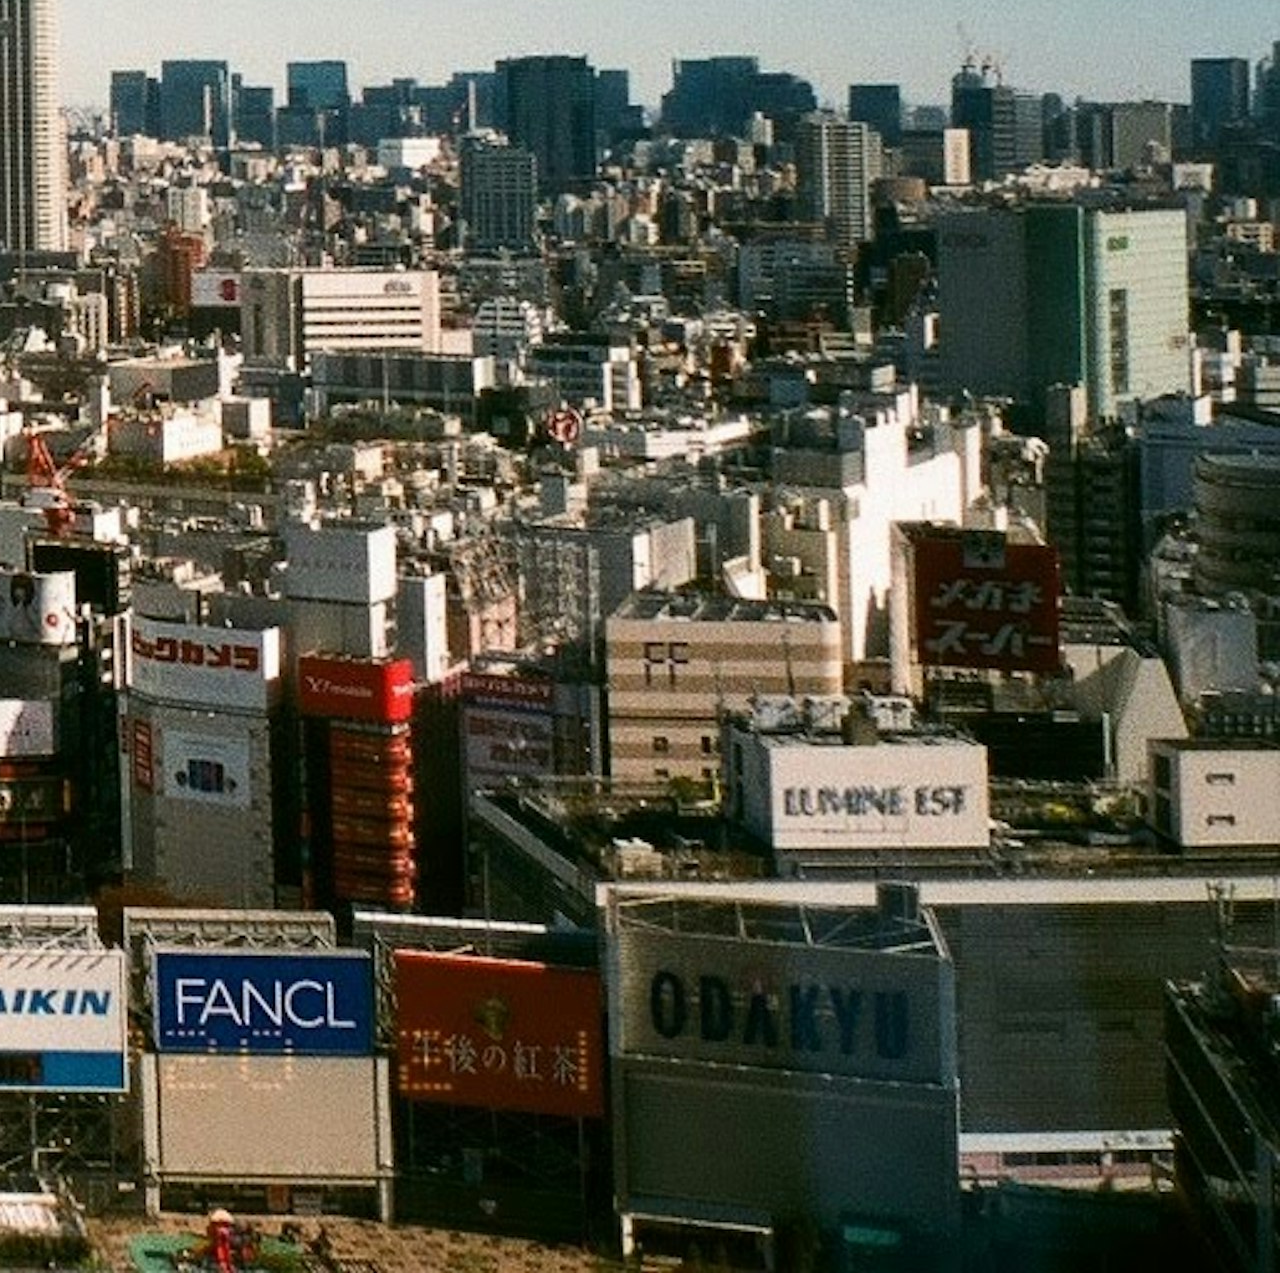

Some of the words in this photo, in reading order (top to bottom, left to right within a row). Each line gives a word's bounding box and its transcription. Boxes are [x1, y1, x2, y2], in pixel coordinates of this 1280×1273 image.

[930, 580, 1042, 613] メガネ
[924, 620, 1052, 658] スーパー
[784, 785, 904, 816] LUMINE
[914, 785, 966, 816] EST
[176, 978, 356, 1029] FANCL
[650, 971, 911, 1060] ODAKYU
[412, 1032, 578, 1086] 午後の紅茶
